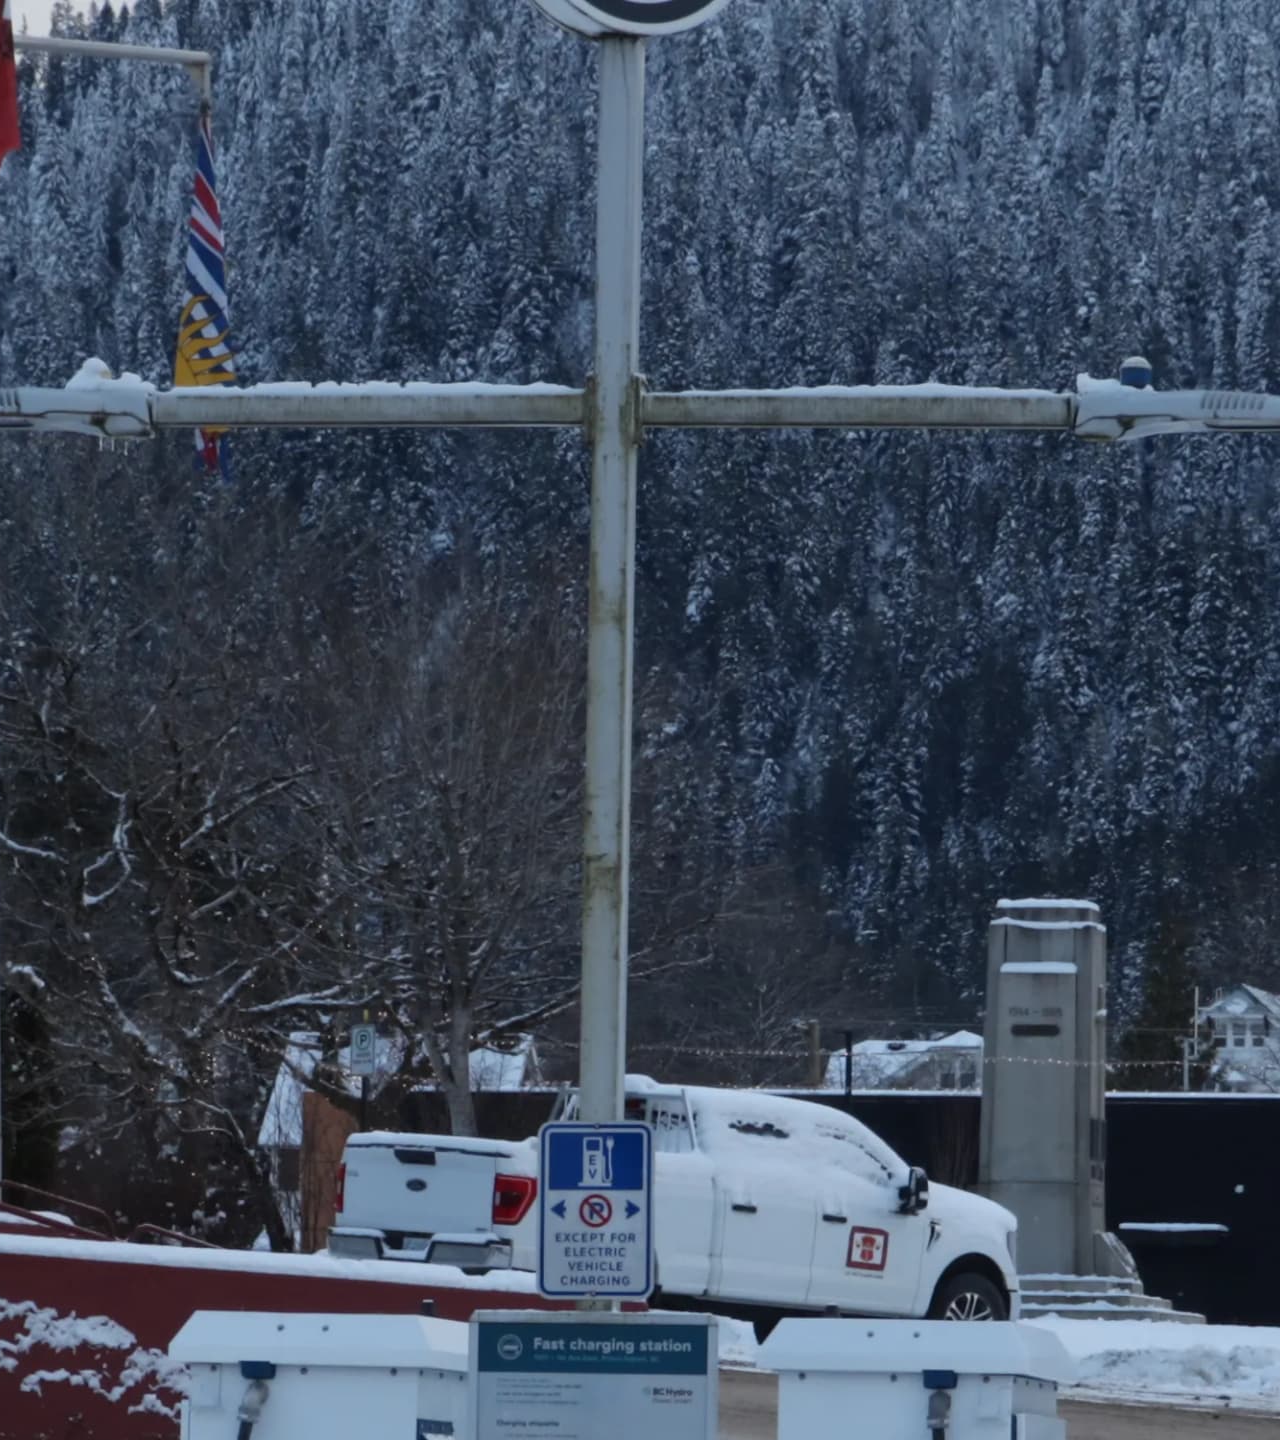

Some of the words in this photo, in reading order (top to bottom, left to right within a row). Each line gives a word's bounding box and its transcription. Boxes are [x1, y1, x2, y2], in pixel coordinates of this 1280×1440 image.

[554, 1232, 606, 1243] EXCEPT
[610, 1232, 637, 1243] FOR
[564, 1247, 627, 1258] ELECTRIC
[568, 1261, 624, 1272] VEHICLE
[560, 1275, 631, 1286] CHARGING
[533, 1337, 565, 1350] Fast
[570, 1338, 634, 1354] charging
[639, 1339, 692, 1353] station
[652, 1387, 665, 1396] BC
[666, 1387, 693, 1398] Hydro
